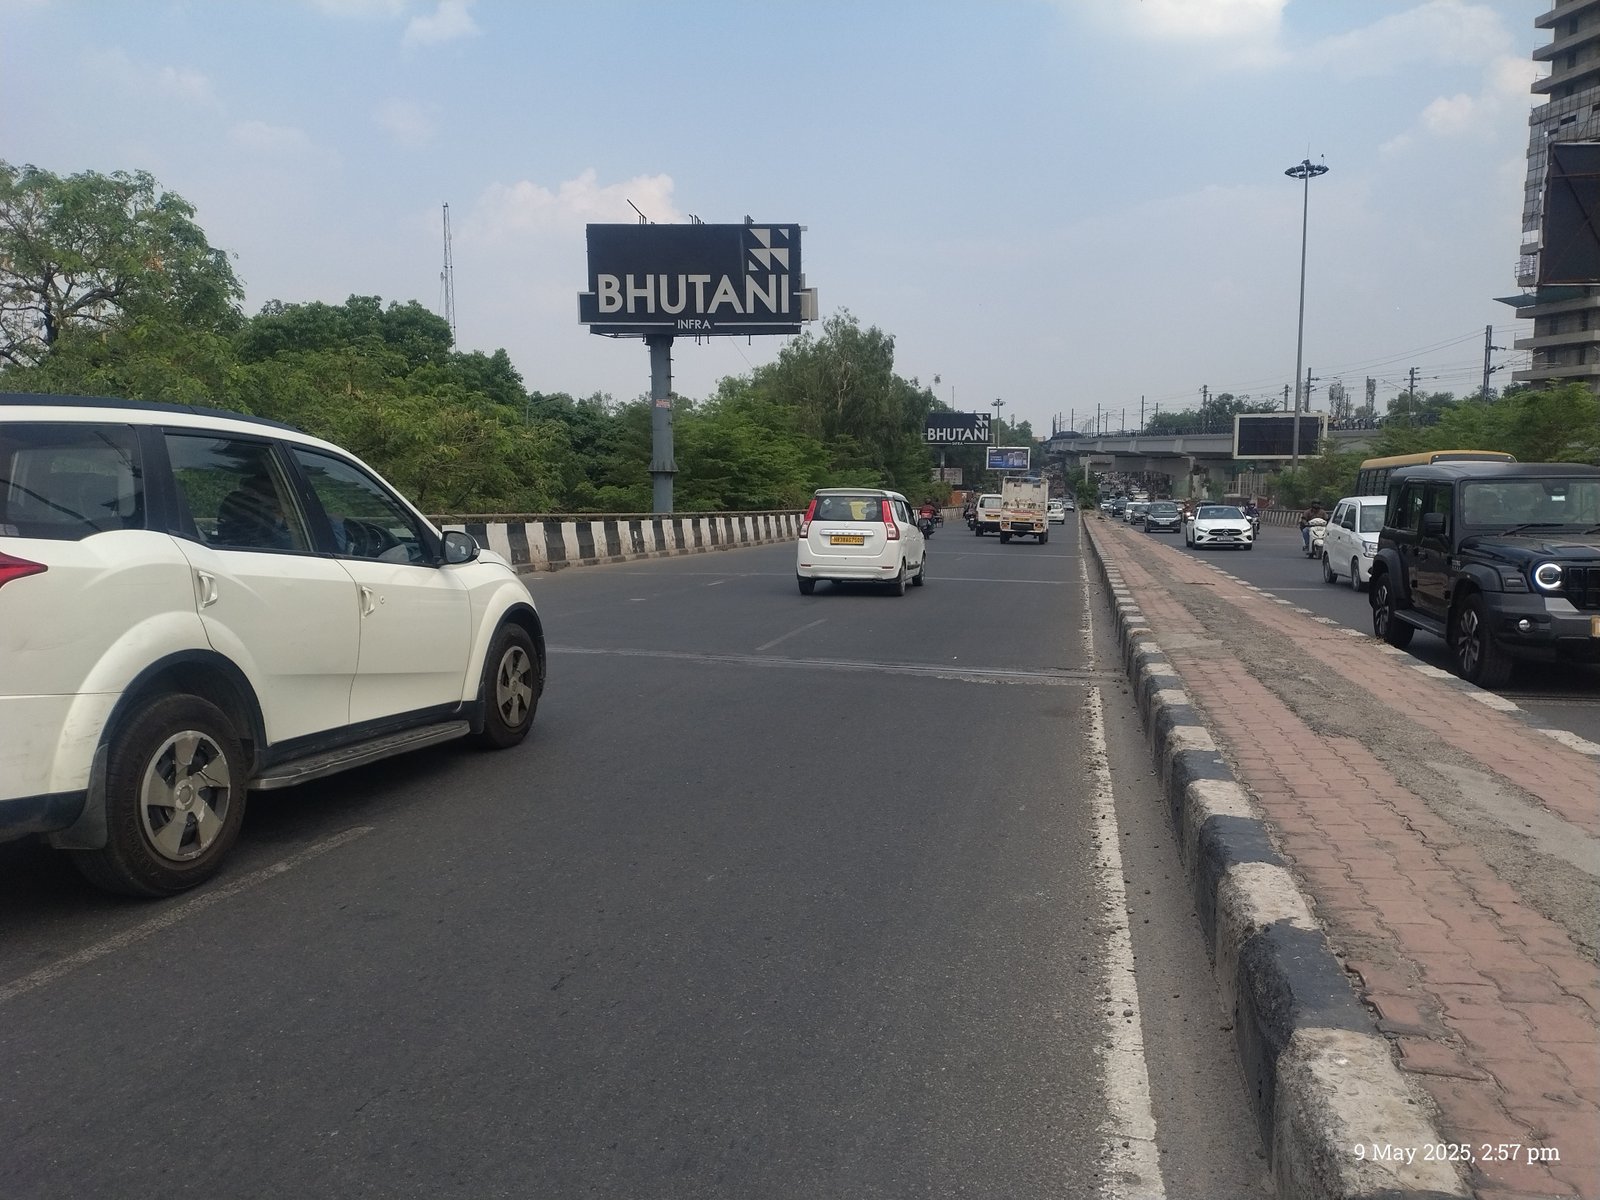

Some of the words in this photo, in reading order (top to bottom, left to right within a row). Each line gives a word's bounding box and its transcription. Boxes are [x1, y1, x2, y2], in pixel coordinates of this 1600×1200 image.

[597, 274, 790, 314] BHUTANI
[677, 319, 711, 329] INFRA
[927, 427, 989, 441] BHUTANI
